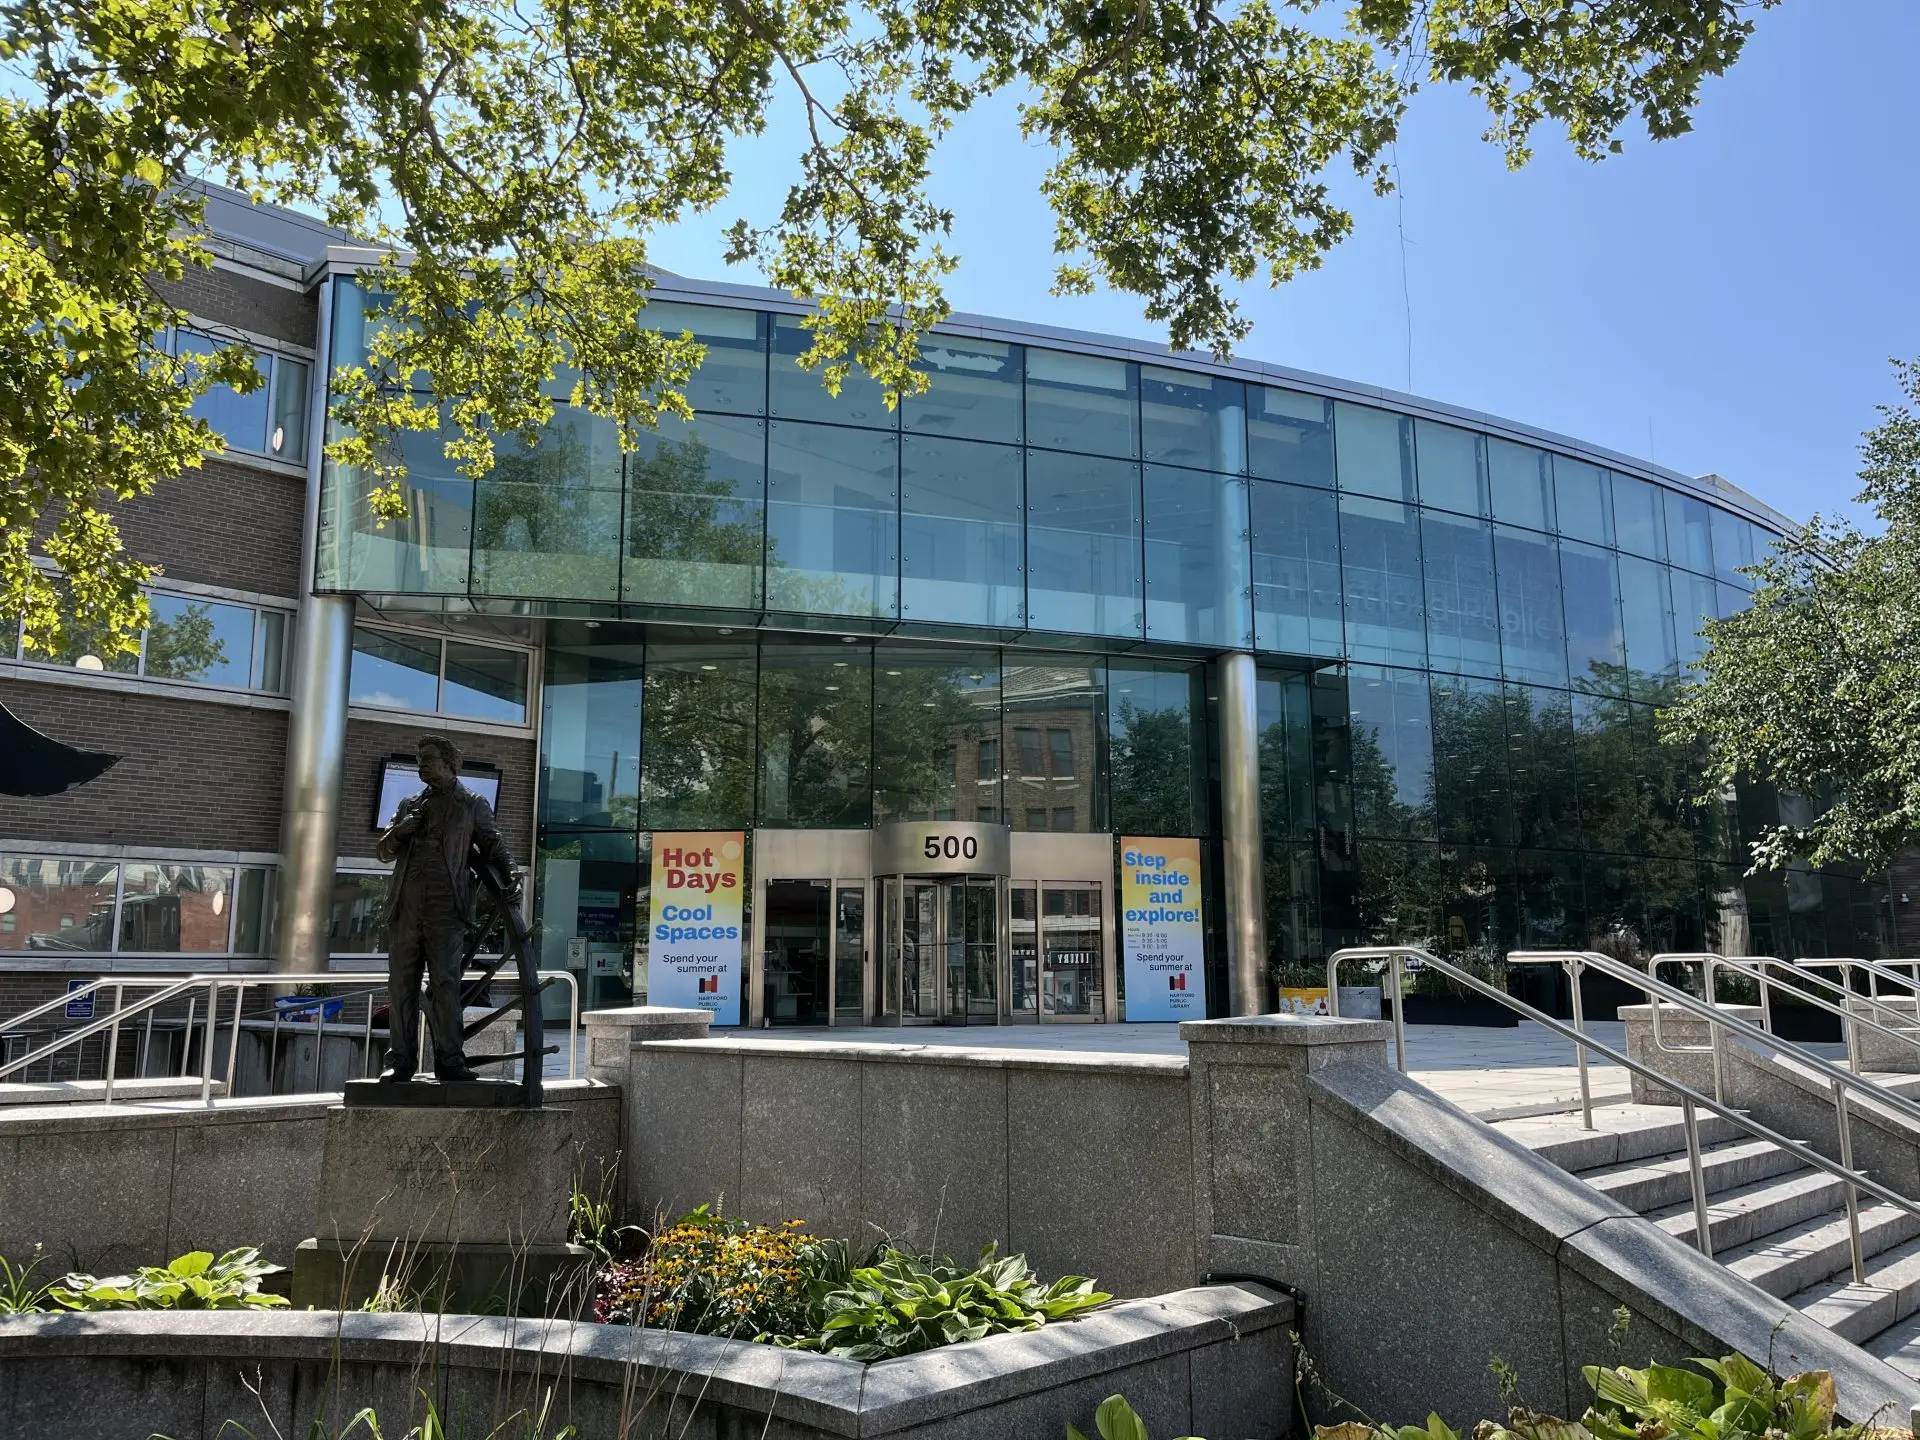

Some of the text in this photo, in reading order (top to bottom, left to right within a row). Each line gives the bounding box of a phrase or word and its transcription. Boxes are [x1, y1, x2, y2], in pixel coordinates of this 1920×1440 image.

[924, 836, 978, 860] 500
[663, 847, 713, 868] Hot
[1124, 851, 1166, 870] Step
[667, 869, 737, 894] Days
[1135, 870, 1190, 886] inside
[1149, 889, 1183, 904] and
[662, 904, 712, 922] Cool
[1125, 907, 1200, 925] explore!
[655, 924, 738, 944] Spaces
[663, 954, 718, 965] Spend your
[1136, 952, 1184, 963] Spend your
[676, 964, 728, 973] summer at
[1184, 963, 1193, 971] at
[385, 1135, 439, 1149] MARK
